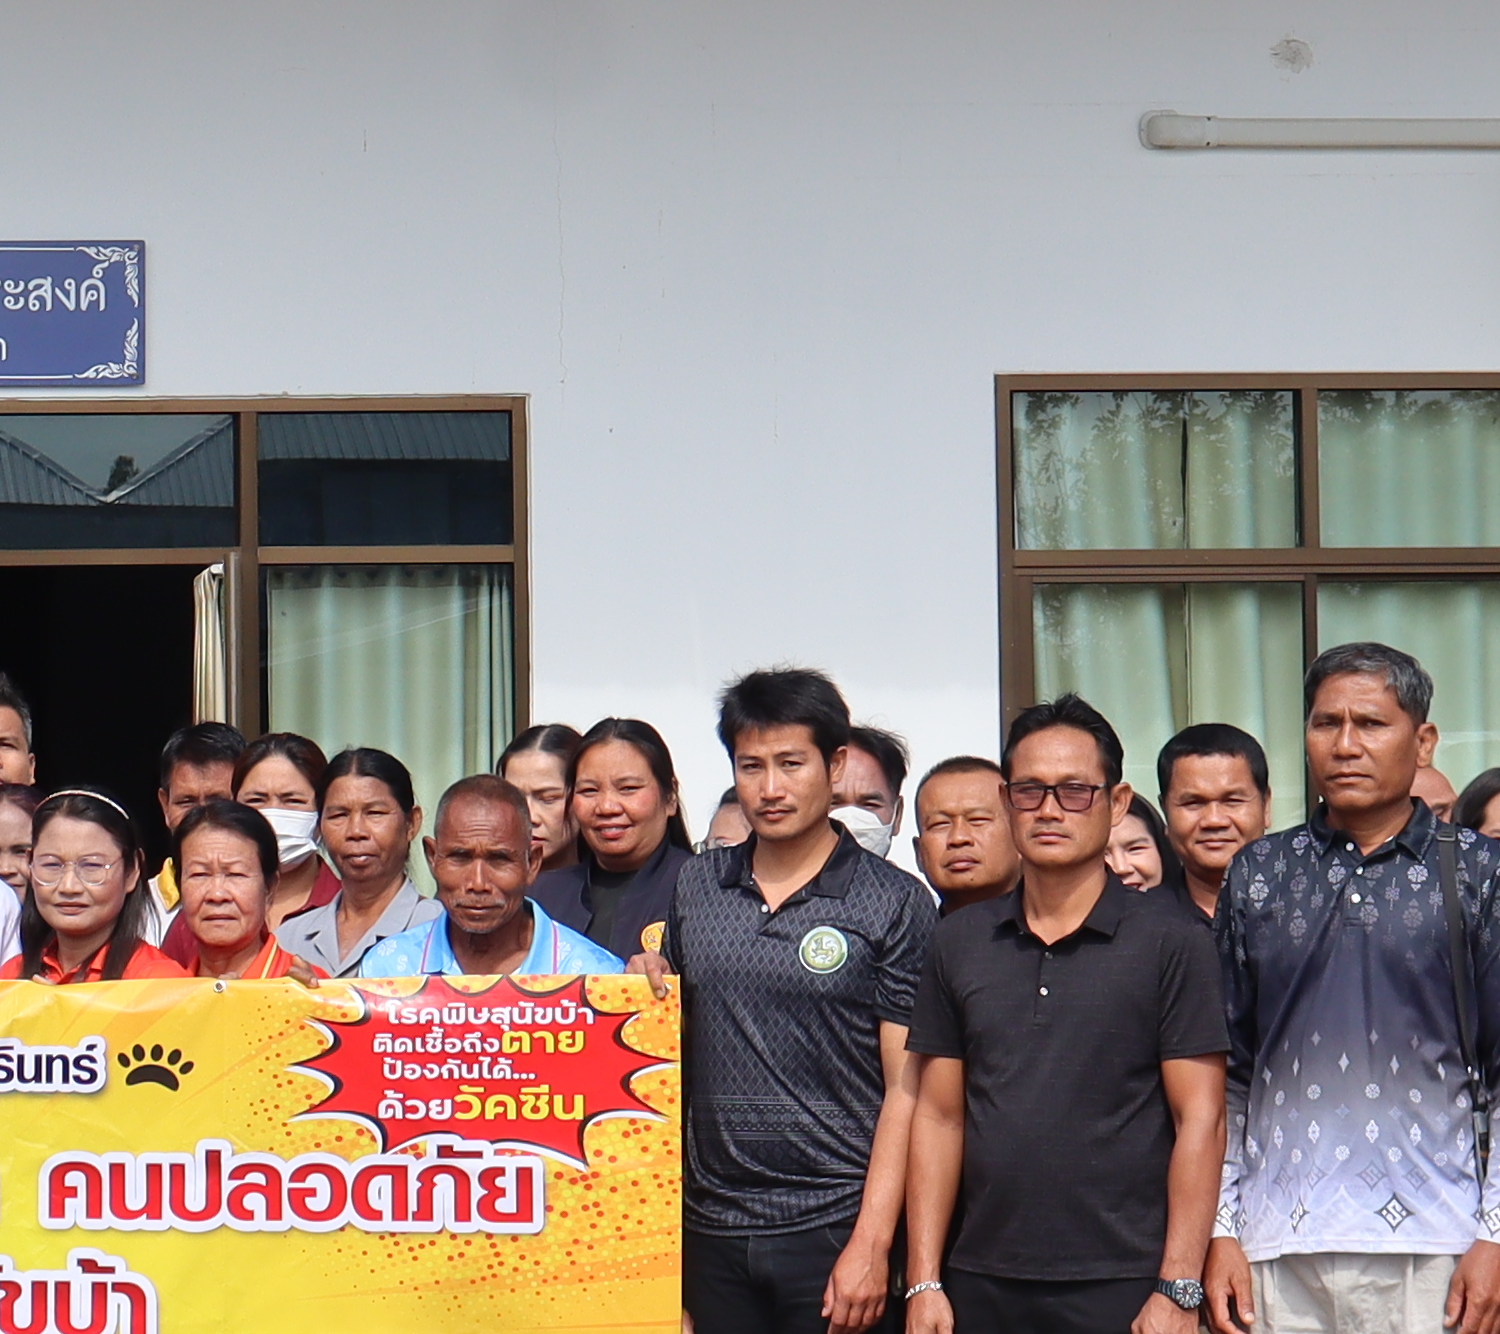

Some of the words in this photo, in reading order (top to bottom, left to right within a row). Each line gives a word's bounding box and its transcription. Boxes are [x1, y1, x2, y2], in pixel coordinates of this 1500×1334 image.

[385, 998, 594, 1030] โรคพิษสุนัขบ้า
[383, 1055, 537, 1080] ป้องกันได้...
[48, 1147, 535, 1226] คนปลอดภัย
